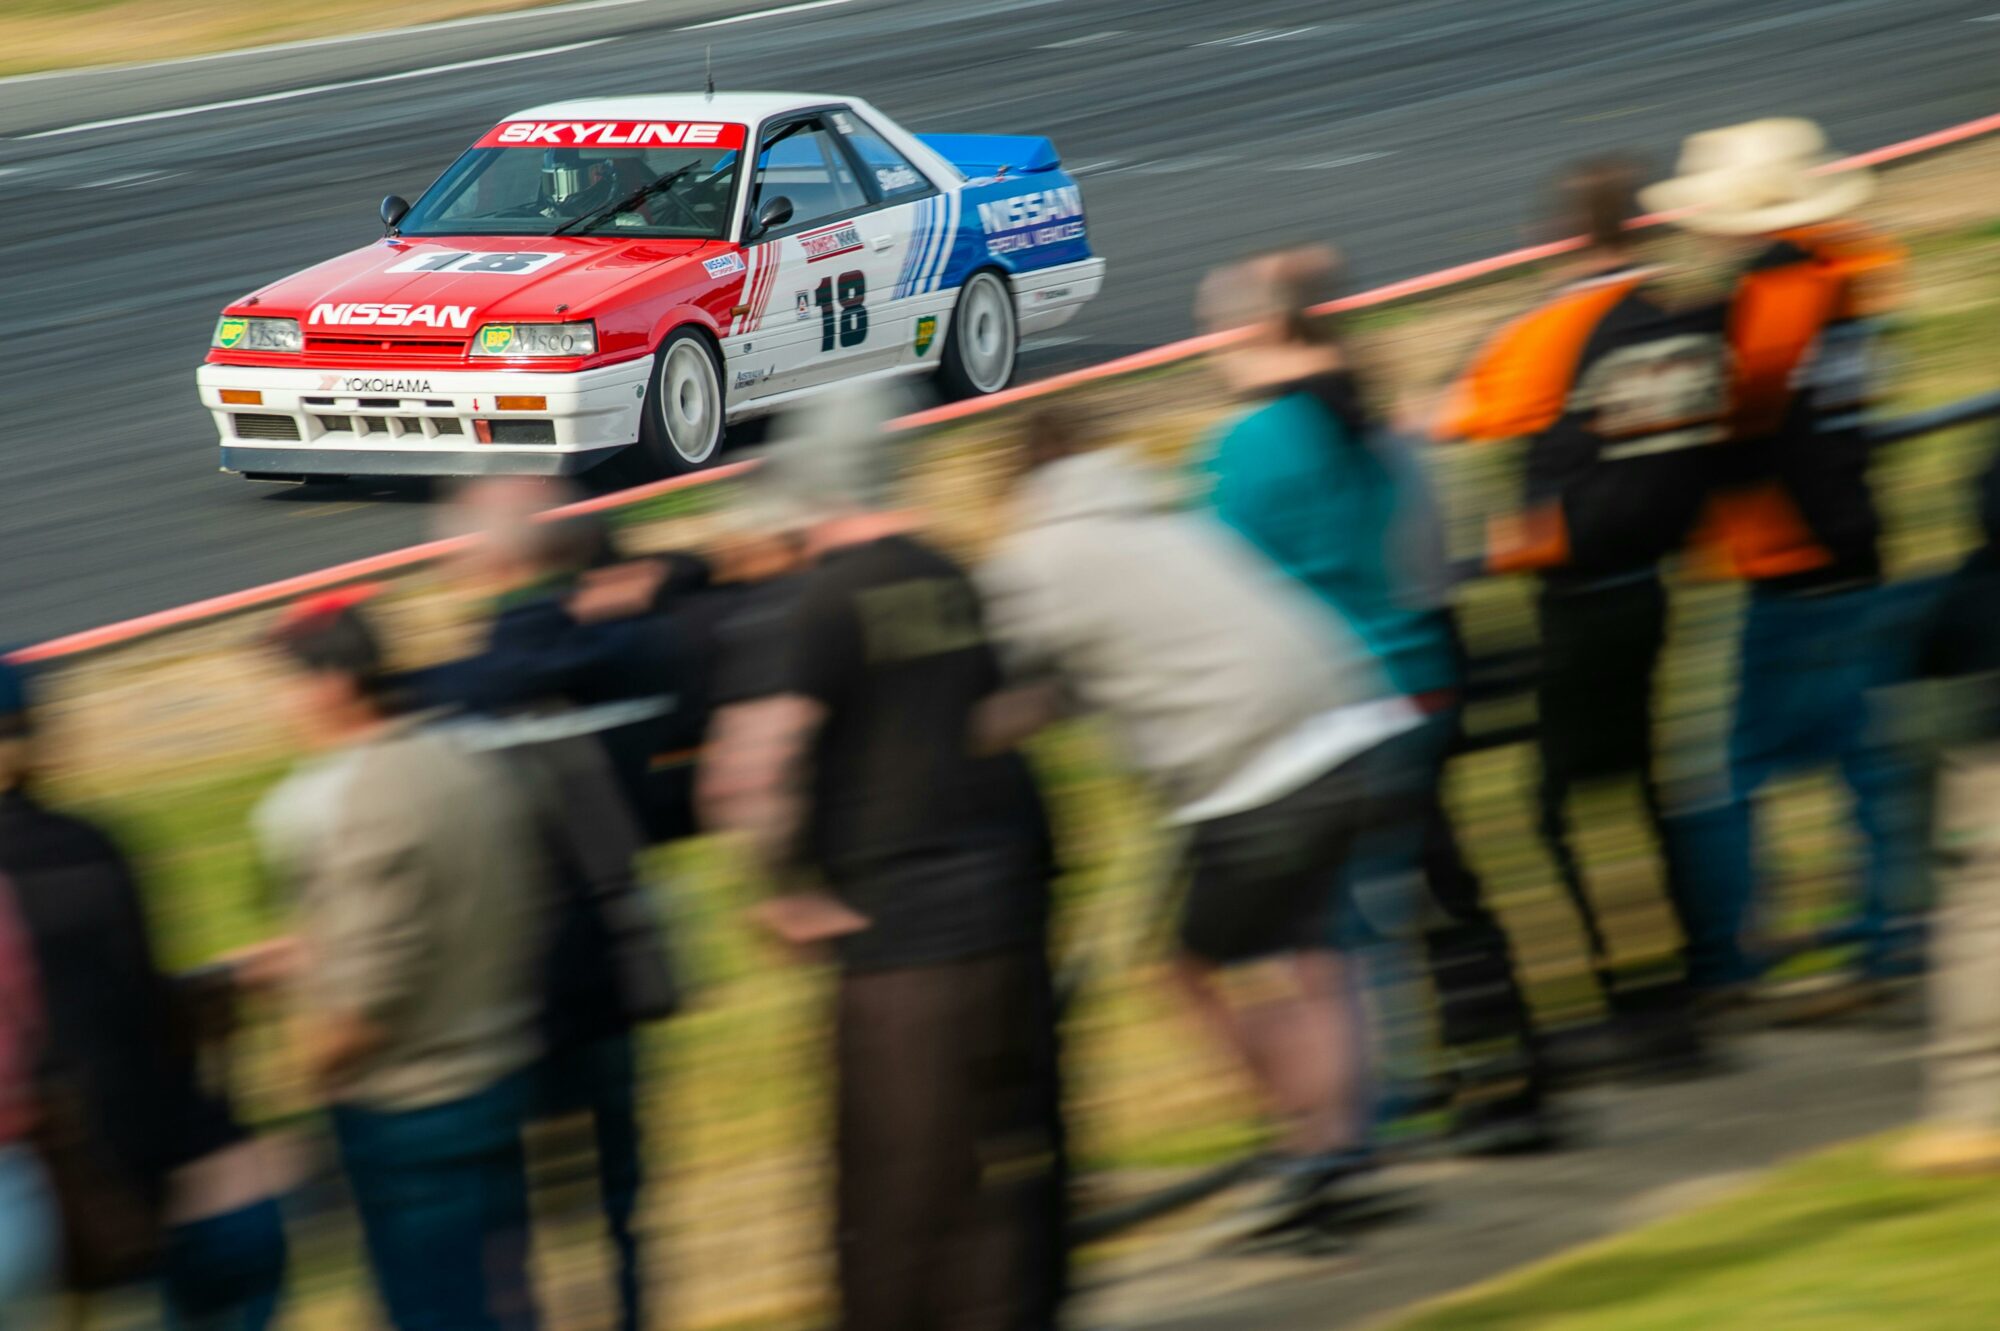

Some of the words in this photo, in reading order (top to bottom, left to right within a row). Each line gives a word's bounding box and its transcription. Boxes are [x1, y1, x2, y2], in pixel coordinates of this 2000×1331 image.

[497, 123, 722, 144] SKYLINE
[976, 184, 1083, 235] NISSAN
[414, 252, 549, 272] 18
[704, 256, 733, 270] NISSAN
[307, 303, 476, 329] NISSAN
[815, 269, 869, 353] 18
[221, 324, 243, 339] BP
[248, 322, 298, 347] Visco
[485, 330, 512, 347] BP
[516, 327, 574, 351] Visco
[342, 377, 433, 393] YOKOHAMA
